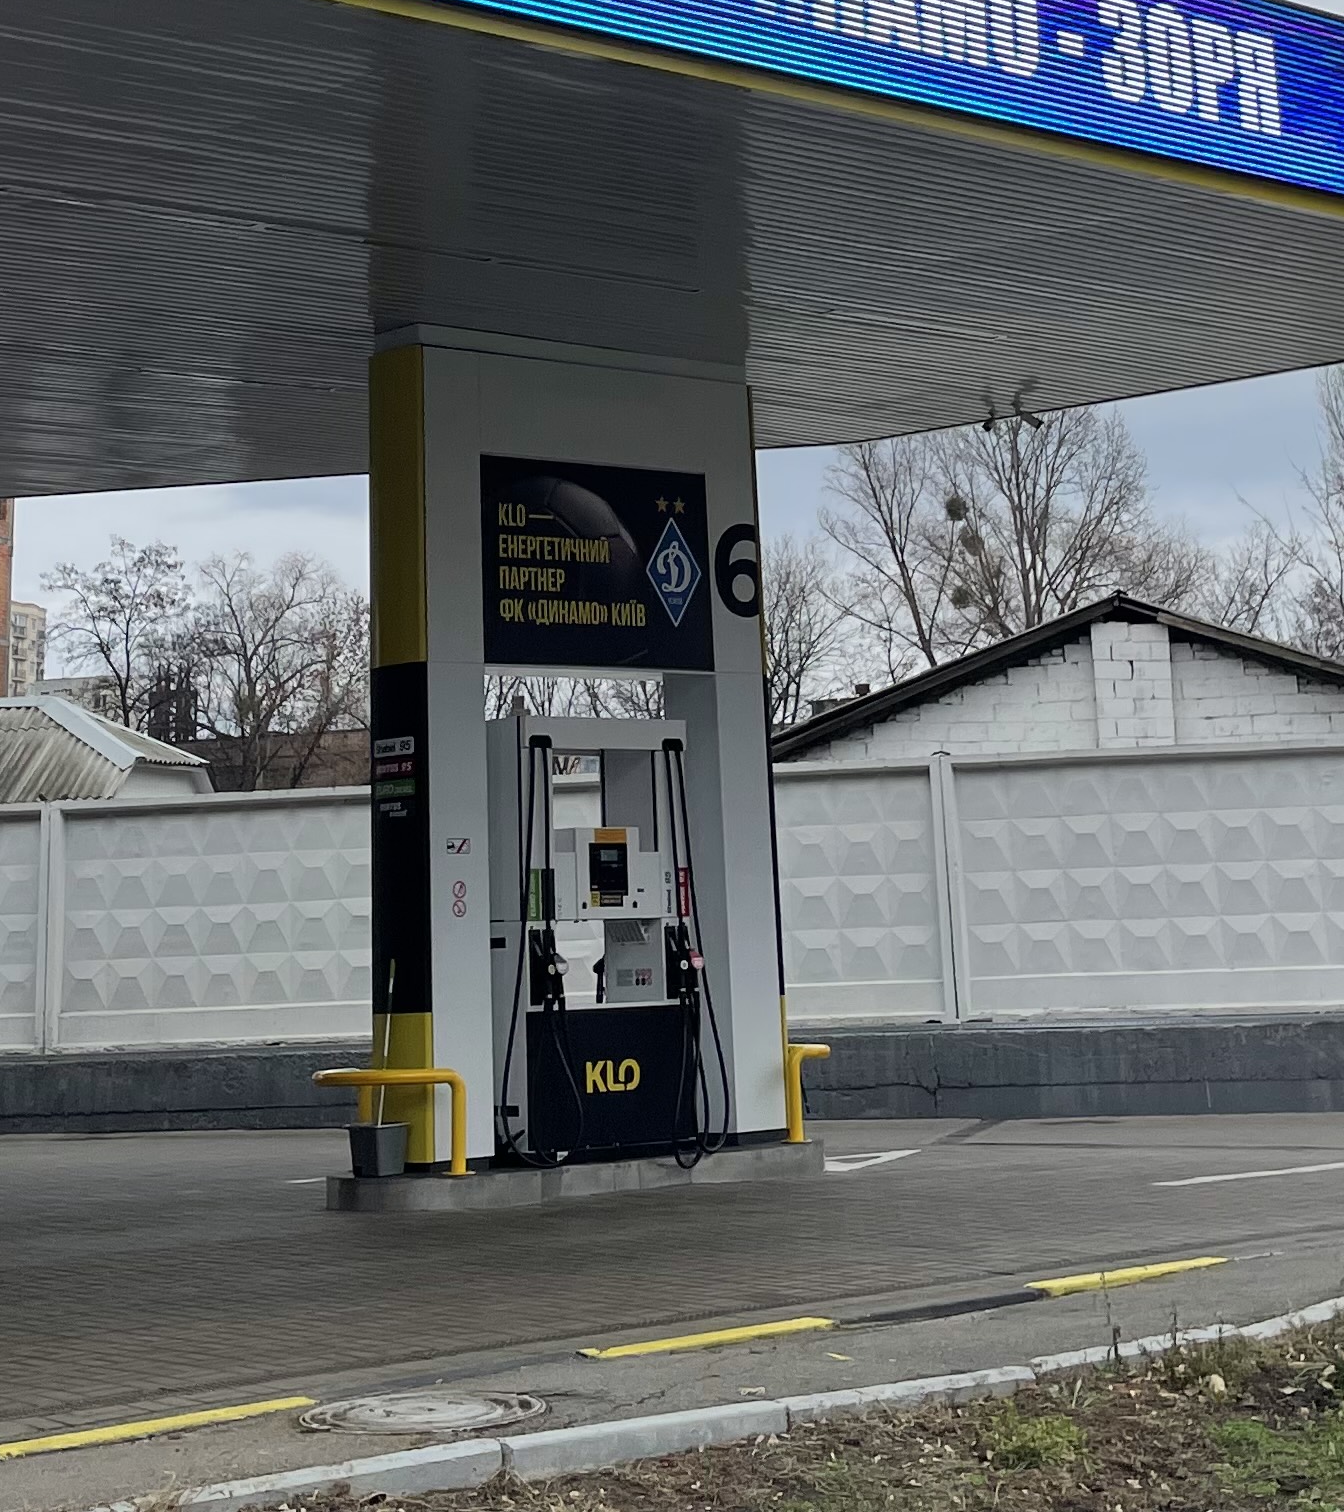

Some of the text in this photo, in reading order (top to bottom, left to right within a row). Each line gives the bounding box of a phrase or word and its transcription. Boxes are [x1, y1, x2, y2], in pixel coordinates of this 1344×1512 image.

[498, 502, 526, 527] KLO
[499, 534, 611, 564] ЕНЕРГЕТИЧНИЙ
[499, 566, 566, 592] ПАРТНЕР
[714, 523, 760, 618] 6
[500, 598, 647, 627] ФК «ДИНАМО» КИЇВ
[586, 1058, 640, 1094] KLO
